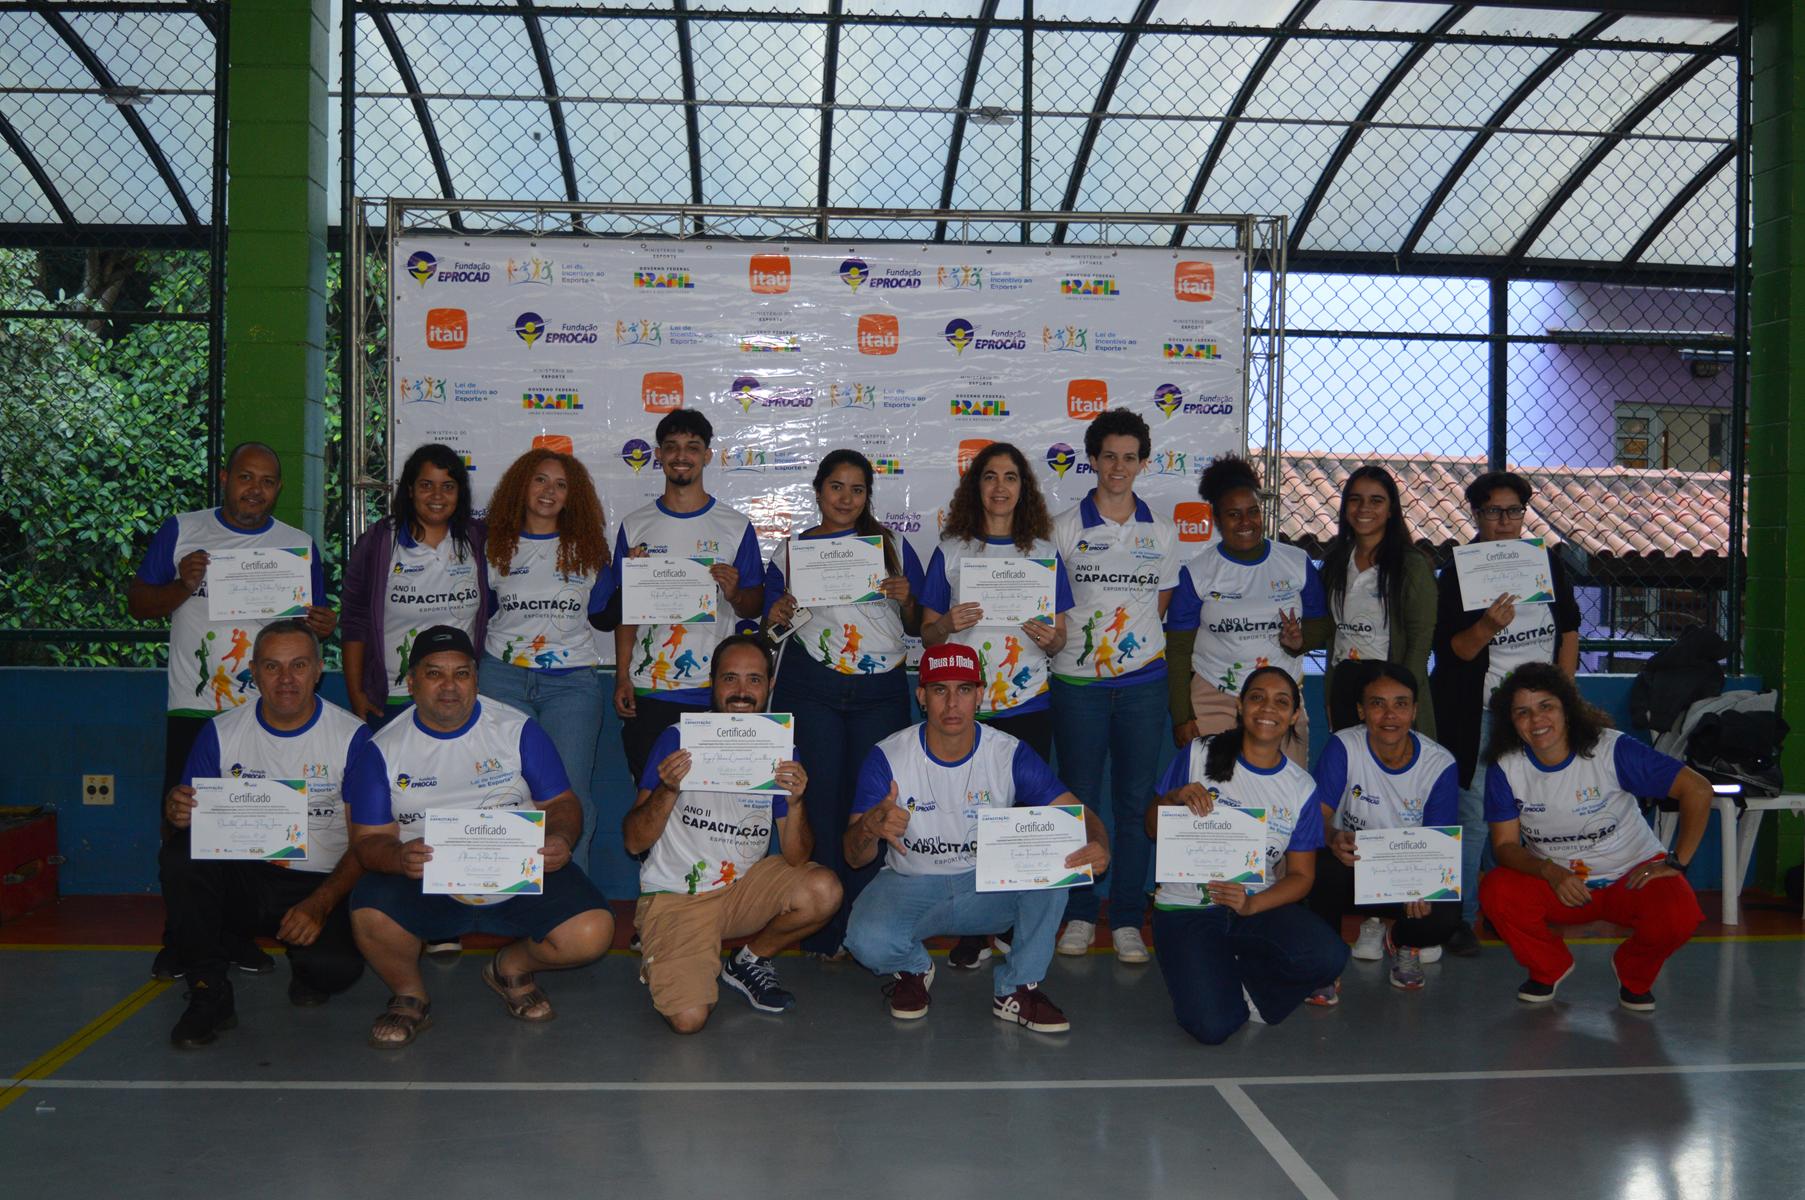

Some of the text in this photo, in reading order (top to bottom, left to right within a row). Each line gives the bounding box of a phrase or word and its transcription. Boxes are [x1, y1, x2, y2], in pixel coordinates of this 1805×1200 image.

[454, 262, 490, 271] Fundação
[438, 272, 490, 282] EPROCAD
[752, 270, 787, 287] itaú
[886, 268, 922, 278] Fundação
[634, 272, 694, 288] BRASIL
[869, 278, 922, 288] EPROCAD
[1060, 279, 1120, 296] BRASIL
[1177, 279, 1212, 296] itaú
[429, 325, 464, 342] itaú
[562, 324, 598, 332] Fundação
[545, 332, 598, 344] EPROCAD
[861, 331, 896, 348] itaú
[991, 330, 1026, 338] Fundação
[974, 338, 1026, 350] EPROCAD
[1163, 344, 1222, 360] BRASIL
[522, 393, 584, 410] BRASIL
[646, 390, 680, 406] itaú
[1200, 394, 1233, 404] Fundação
[950, 400, 1010, 416] BRASIL
[1071, 396, 1104, 412] itaú
[1183, 404, 1233, 415] EPROCAD
[886, 512, 921, 521] Fundação
[1176, 518, 1208, 534] itaú
[820, 550, 854, 560] Certificado
[1486, 551, 1520, 561] Certificado
[240, 560, 278, 570] Certificado
[652, 568, 686, 578] Certificado
[992, 570, 1026, 578] Certificado
[1074, 573, 1160, 586] CAPACITAÇÃO
[392, 584, 409, 592] ANO
[390, 588, 478, 604] CAPACITAÇÃO
[1488, 624, 1555, 646] APACITAÇ
[928, 656, 948, 670] Deus
[716, 727, 757, 738] Certificado
[230, 792, 271, 803] Certificado
[684, 805, 704, 816] ANO
[464, 824, 507, 836] Certificado
[682, 814, 769, 839] CAPACITAÇÃO
[1015, 822, 1055, 832] Certificado
[1192, 820, 1232, 830] Certificado
[904, 838, 978, 856] CAPACITAÇ
[1389, 840, 1428, 850] Certificado
